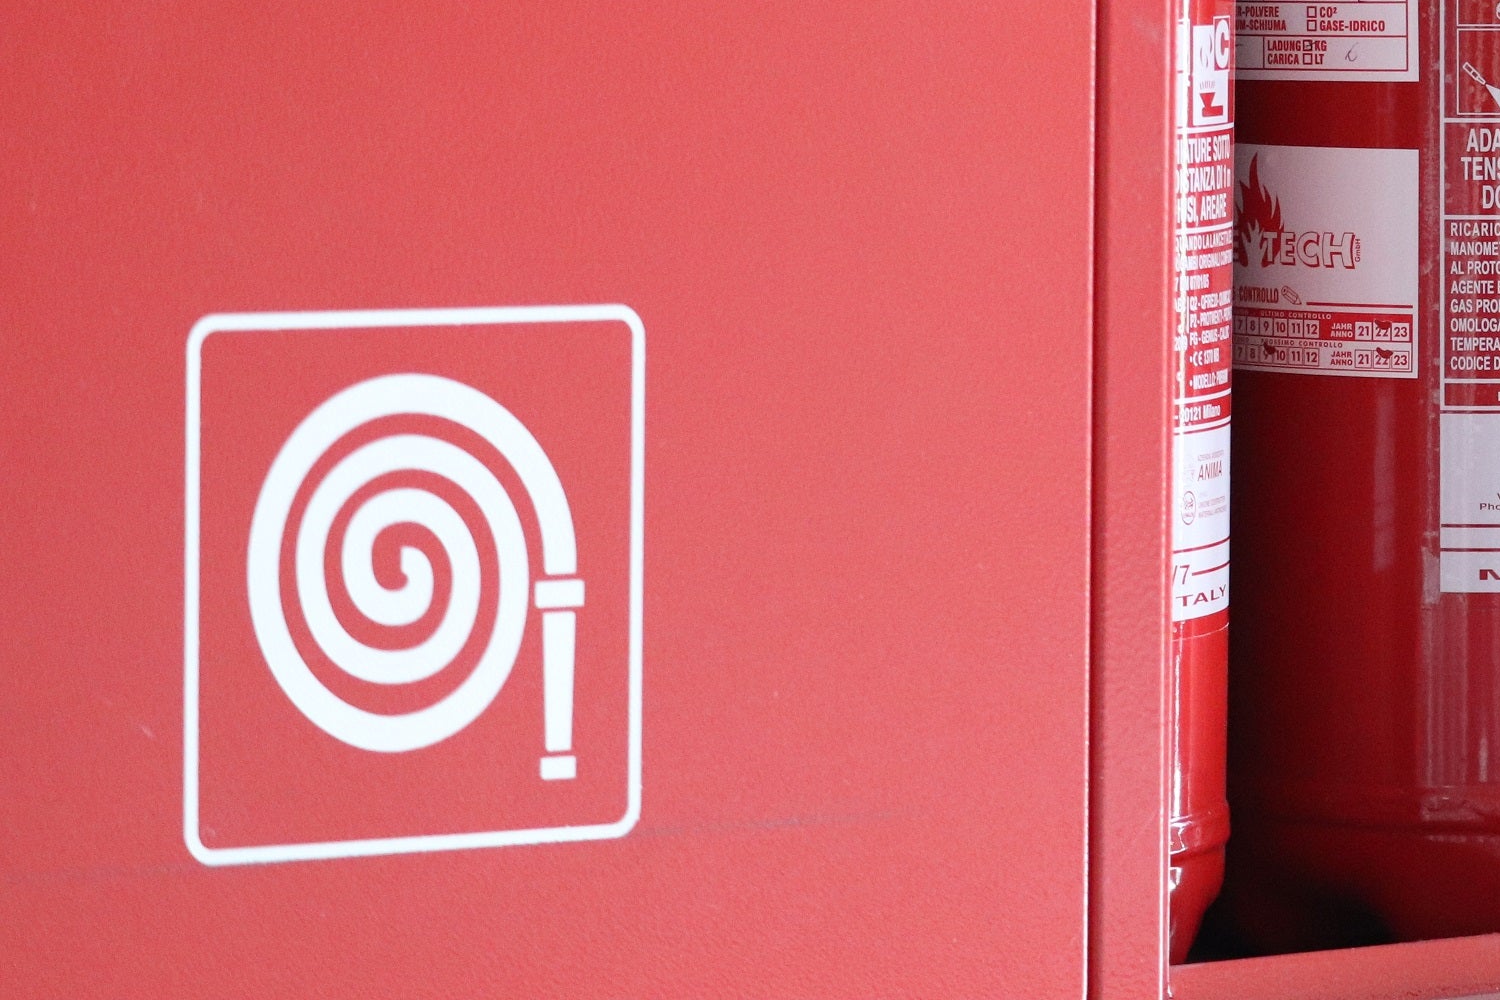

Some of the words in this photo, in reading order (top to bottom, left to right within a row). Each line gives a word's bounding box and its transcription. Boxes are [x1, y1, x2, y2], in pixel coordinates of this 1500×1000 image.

[1320, 21, 1385, 31] GASE-IDRICO
[1216, 19, 1229, 69] C
[1268, 40, 1301, 51] LADUNG
[1268, 54, 1299, 64] CARICA
[1315, 54, 1324, 64] LT
[1450, 261, 1464, 275] AL
[1451, 281, 1494, 294] AGENTE
[1240, 286, 1278, 304] CONTROLLO
[1450, 299, 1473, 313] GAS
[1276, 322, 1285, 333] 10
[1291, 323, 1300, 334] 11
[1306, 324, 1316, 334] 12
[1358, 326, 1369, 336] 21
[1394, 326, 1407, 336] 23
[1299, 340, 1342, 348] CONTROLLO
[1306, 352, 1317, 363] 12
[1358, 353, 1369, 364] 21
[1394, 354, 1407, 365] 23
[1450, 356, 1490, 370] CODICE
[1198, 460, 1222, 481] ANIMA
